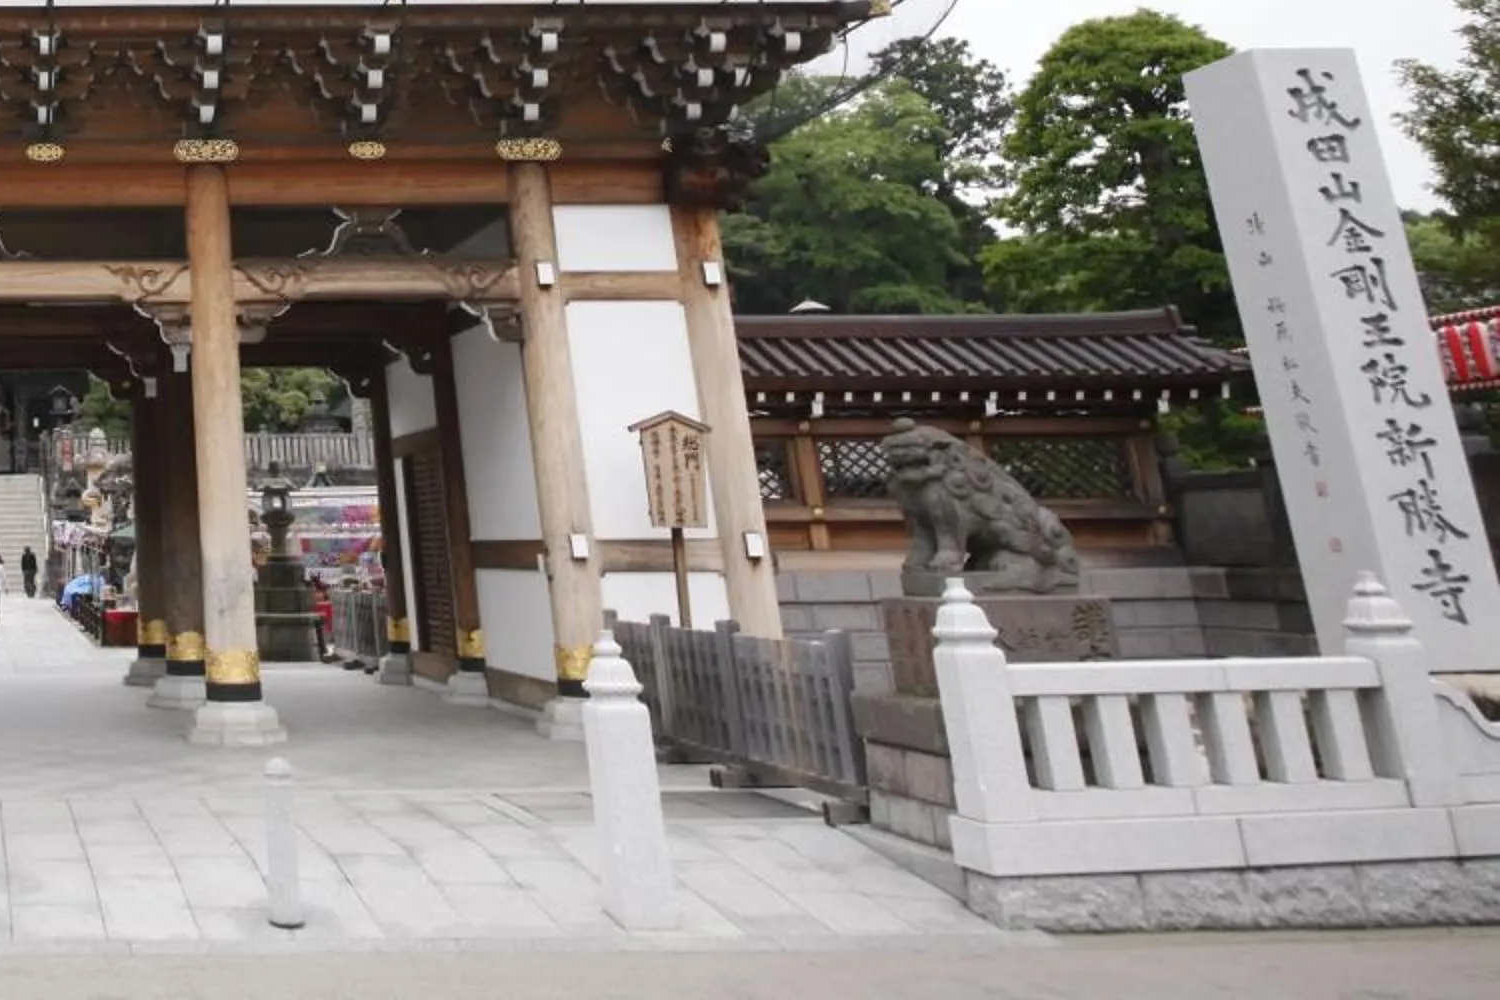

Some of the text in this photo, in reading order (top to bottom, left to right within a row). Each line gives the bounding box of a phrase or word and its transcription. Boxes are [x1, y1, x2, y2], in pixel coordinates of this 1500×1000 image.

[1287, 68, 1470, 626] 成田山金剛王院新勝寺
